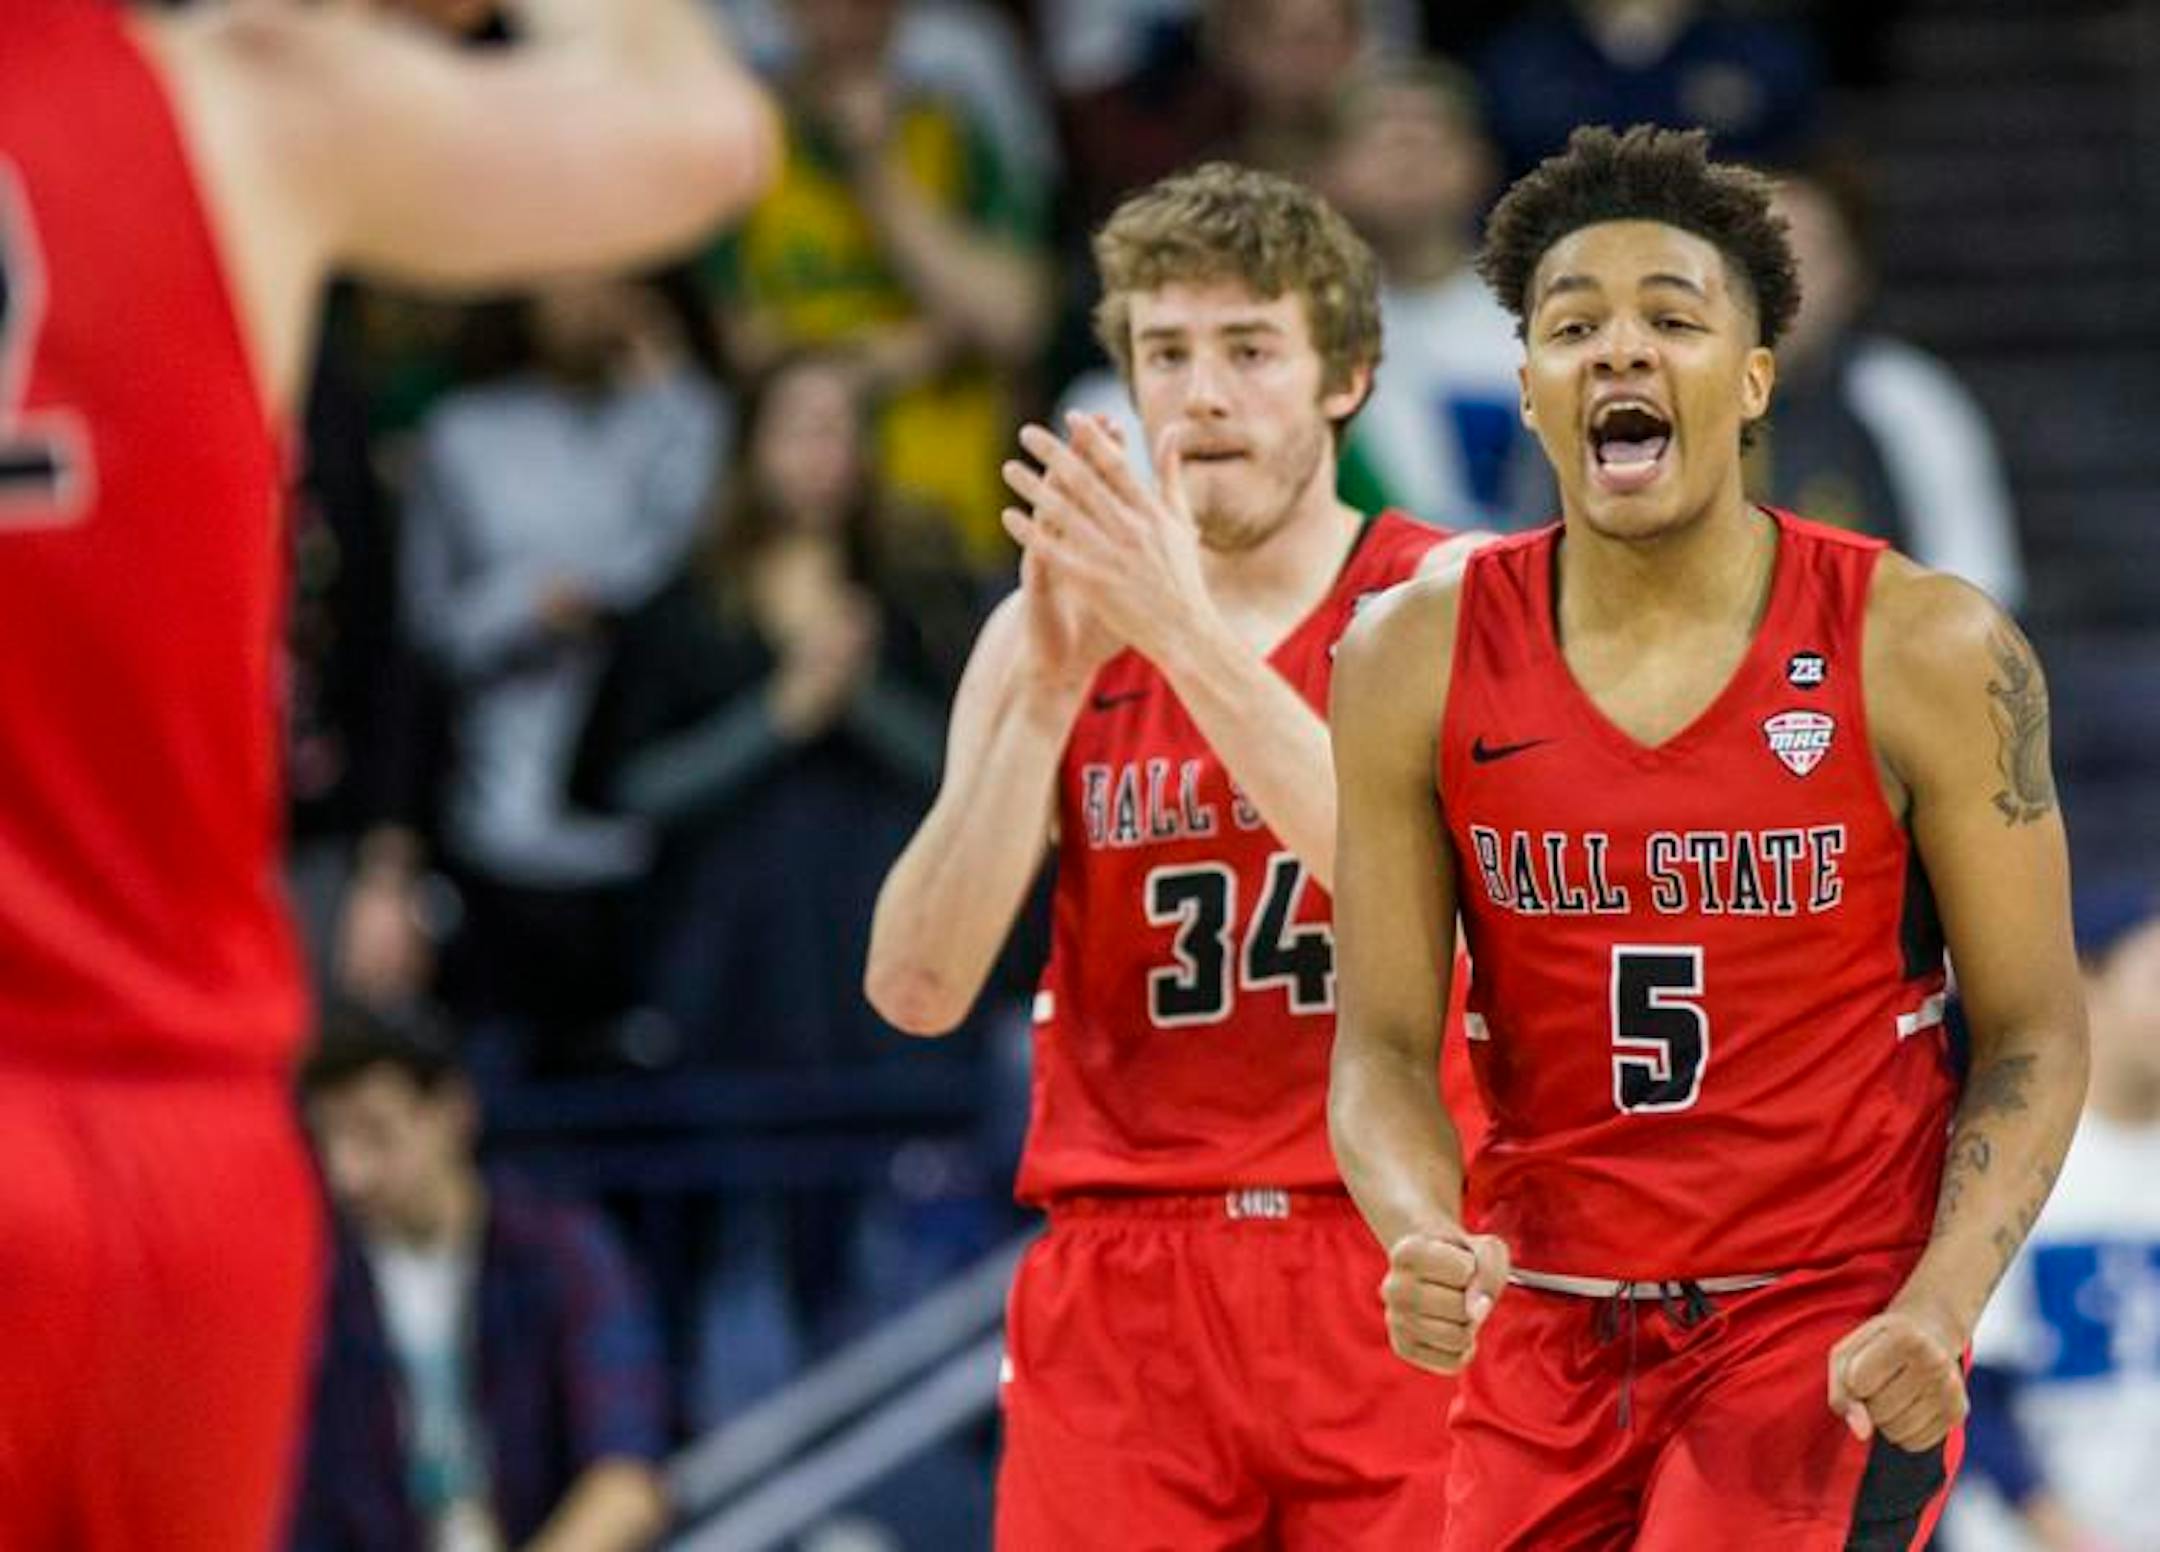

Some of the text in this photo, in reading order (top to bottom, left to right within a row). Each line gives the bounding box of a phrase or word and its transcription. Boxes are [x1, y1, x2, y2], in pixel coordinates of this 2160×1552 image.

[1770, 730, 1831, 750] MAC
[1470, 824, 1845, 915] BALL STATE
[1145, 850, 1336, 1028] 34
[1610, 944, 1709, 1113] 5
